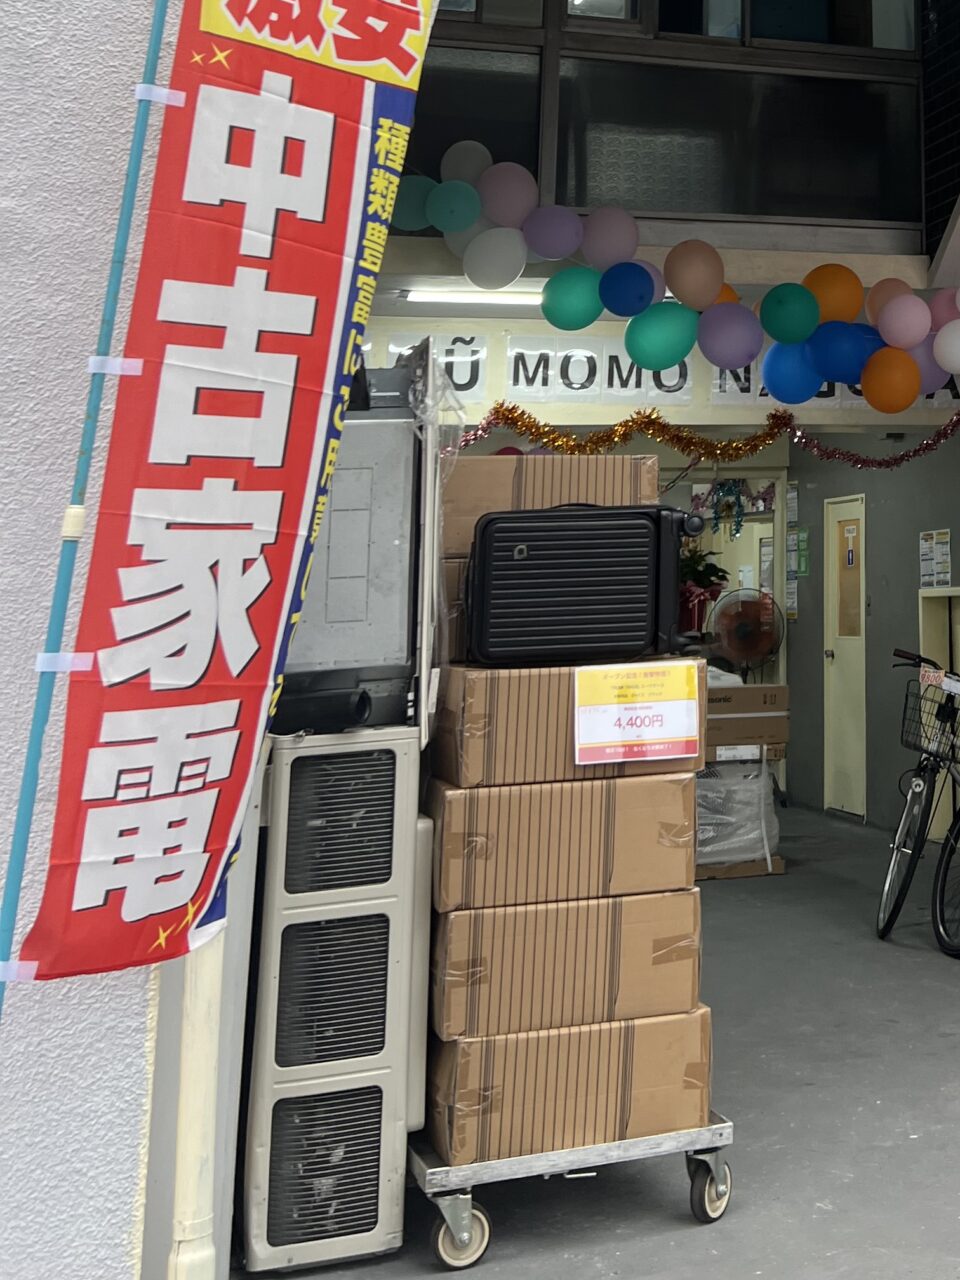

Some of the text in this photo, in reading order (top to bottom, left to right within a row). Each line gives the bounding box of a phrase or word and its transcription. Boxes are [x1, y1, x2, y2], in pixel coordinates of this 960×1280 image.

[513, 351, 688, 393] MOMO
[72, 70, 336, 923] 中古家電
[614, 714, 664, 730] 4,400円
